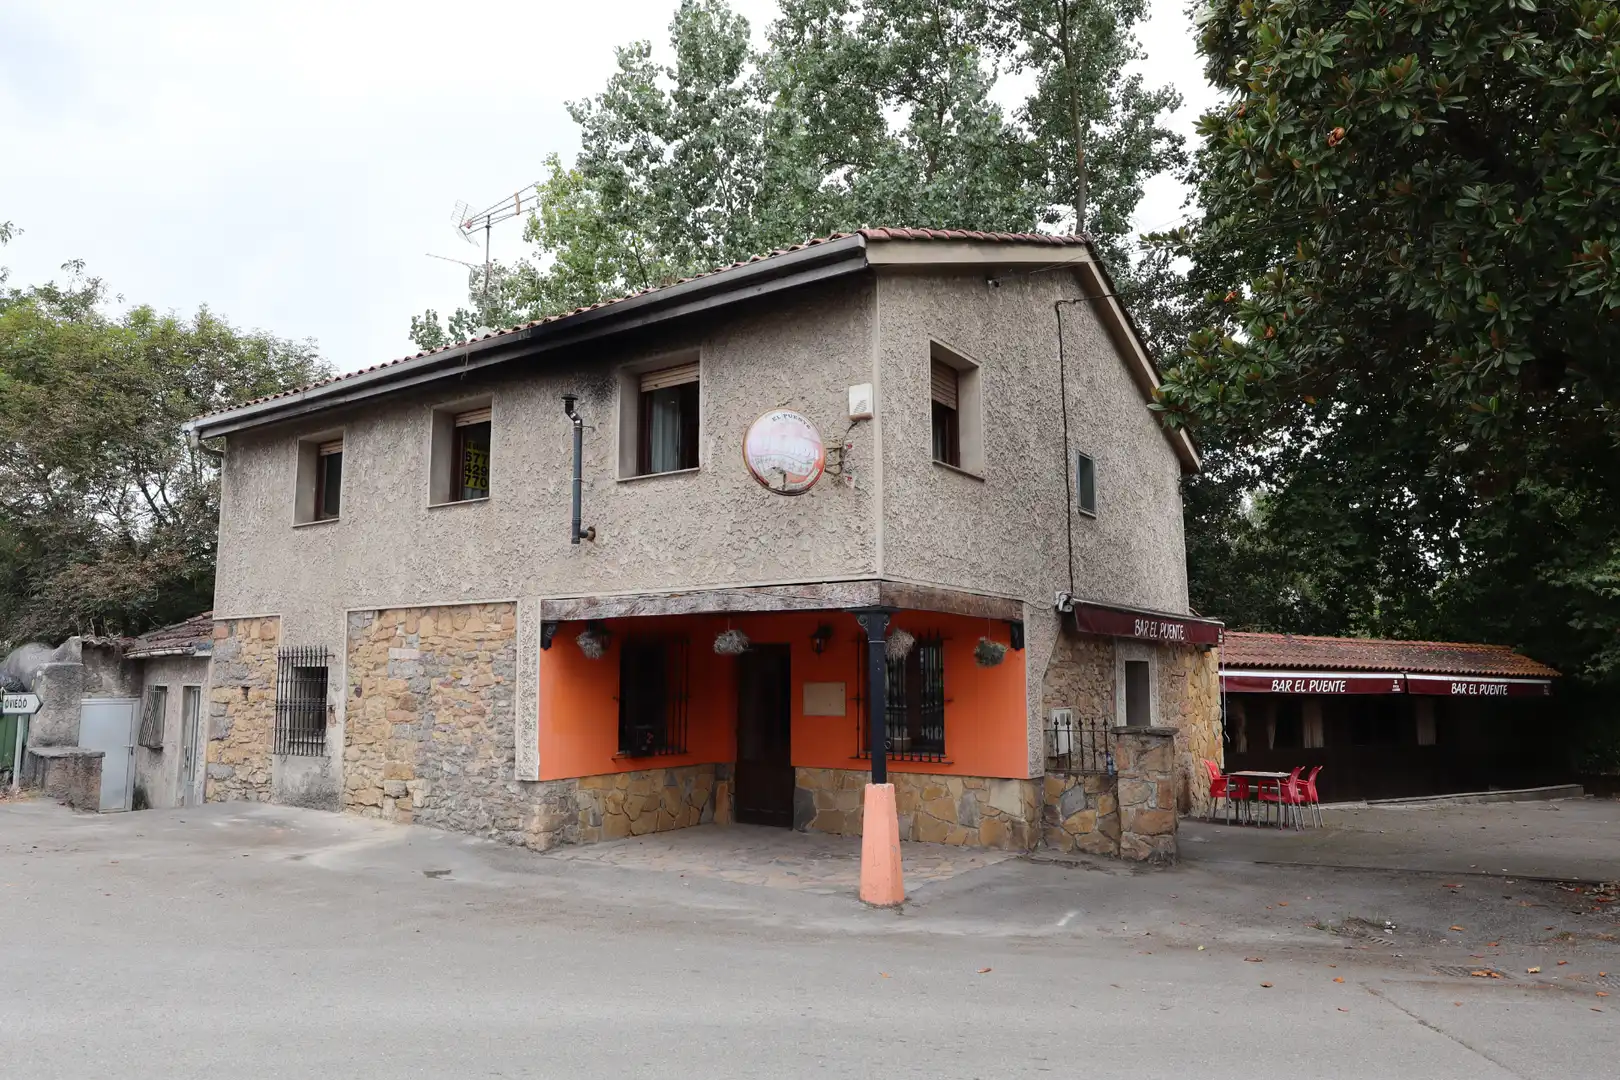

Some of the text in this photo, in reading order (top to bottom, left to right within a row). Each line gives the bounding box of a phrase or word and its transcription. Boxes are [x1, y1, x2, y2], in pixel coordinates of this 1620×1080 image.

[783, 413, 812, 430] PUENTE
[465, 463, 487, 477] 429
[465, 474, 487, 488] 770
[1134, 618, 1185, 641] BAR EL PUENTE
[1271, 679, 1346, 693] BAR EL PUENTE
[1451, 682, 1508, 696] BAR EL PUENTE
[4, 698, 28, 709] OVIEDO
